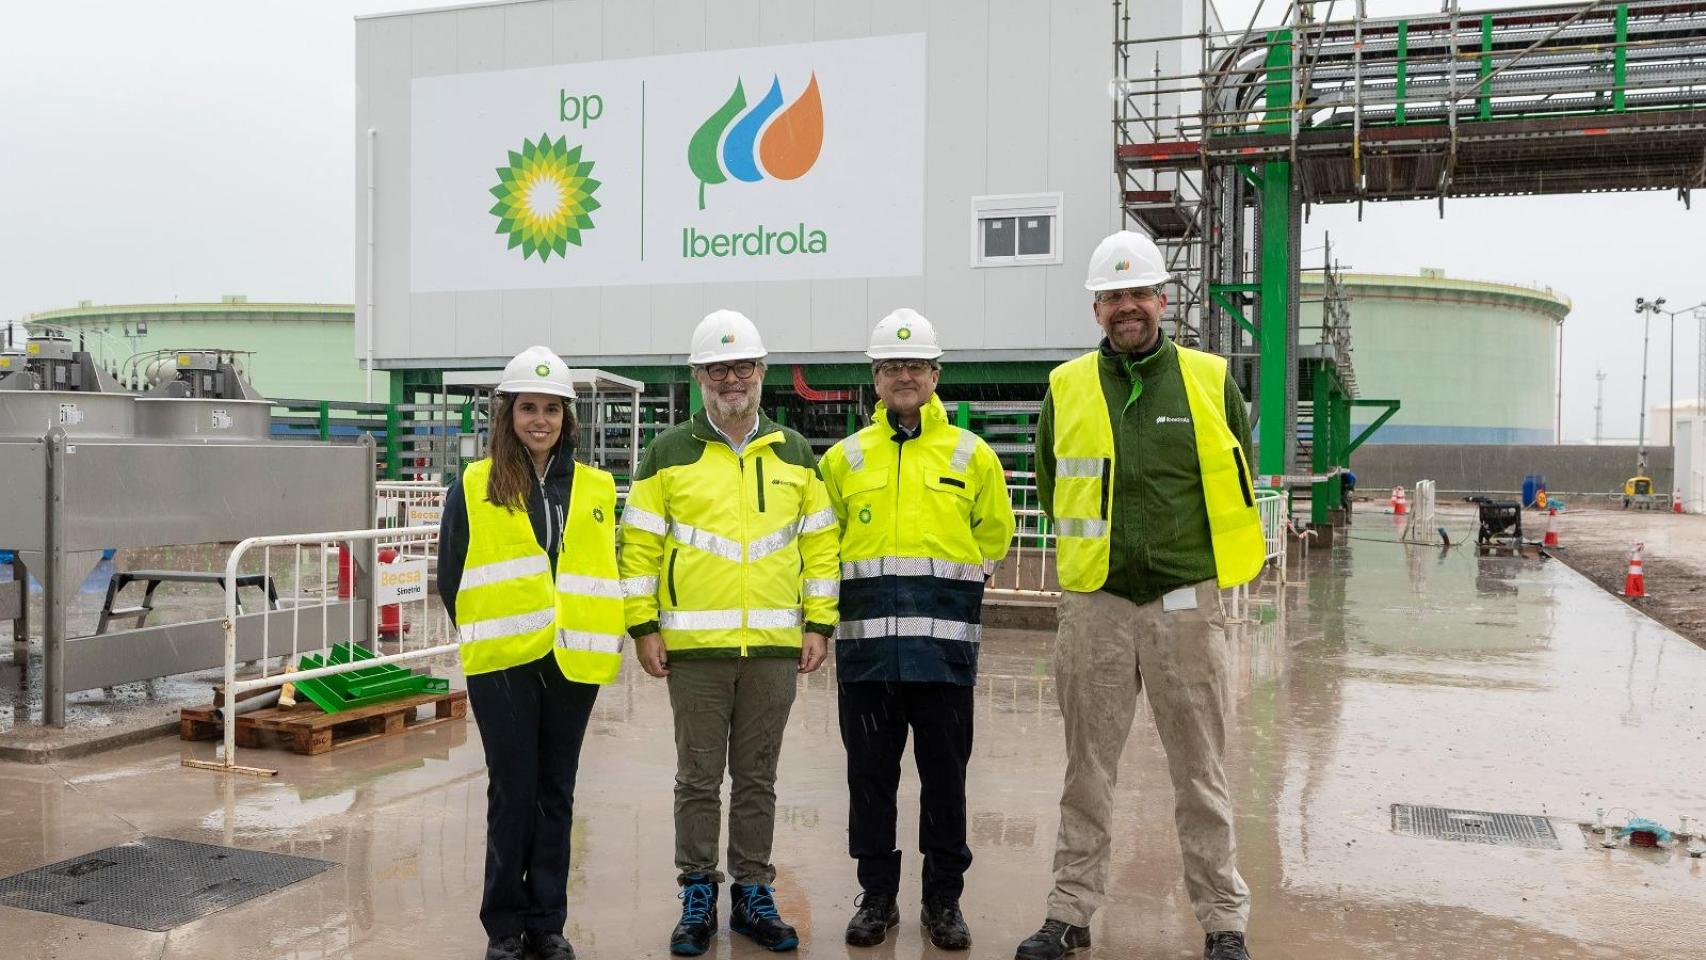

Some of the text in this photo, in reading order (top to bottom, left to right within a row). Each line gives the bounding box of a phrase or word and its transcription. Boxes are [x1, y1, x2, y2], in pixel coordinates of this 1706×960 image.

[560, 88, 603, 129] bp
[682, 223, 827, 258] Iberdrola
[411, 510, 439, 520] Becsa
[381, 570, 421, 586] Becsa
